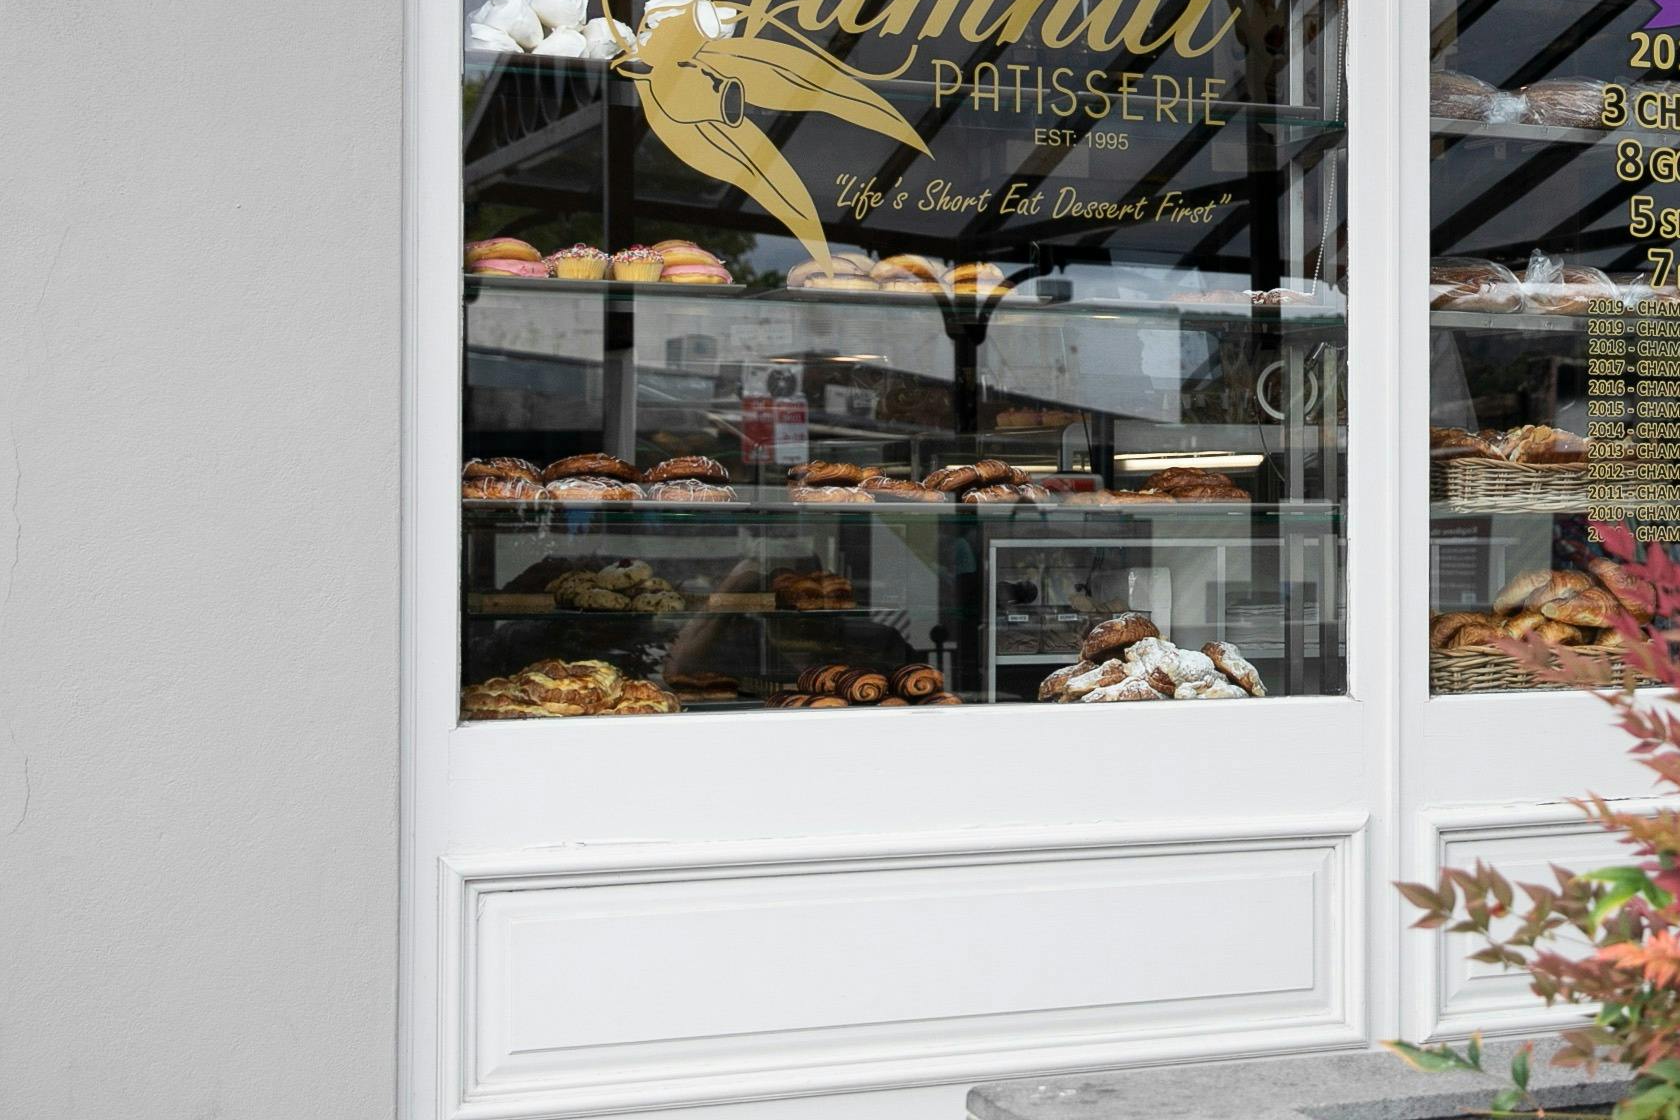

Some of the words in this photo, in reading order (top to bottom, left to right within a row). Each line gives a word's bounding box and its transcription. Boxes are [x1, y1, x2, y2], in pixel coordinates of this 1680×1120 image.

[931, 59, 1227, 126] PATISSERIE
[1601, 83, 1626, 127] 3
[1034, 129, 1077, 147] EST:
[1085, 132, 1129, 151] 1995
[1616, 138, 1644, 181] 8
[918, 179, 992, 212] Short
[1000, 183, 1045, 215] Eat
[1052, 187, 1145, 221] Dessert
[1630, 195, 1655, 237] 5
[1648, 248, 1674, 290] 7
[1588, 299, 1624, 315] 2019
[1588, 320, 1624, 335] 2019
[1589, 340, 1625, 355] 2018
[1588, 359, 1625, 375] 2017
[1588, 380, 1625, 396] 2016
[1588, 401, 1625, 417] 2015
[1588, 422, 1625, 438] 2014
[1588, 443, 1625, 458] 2013
[1588, 463, 1624, 479] 2012
[1588, 484, 1624, 500] 2011
[1588, 505, 1624, 521] 2010
